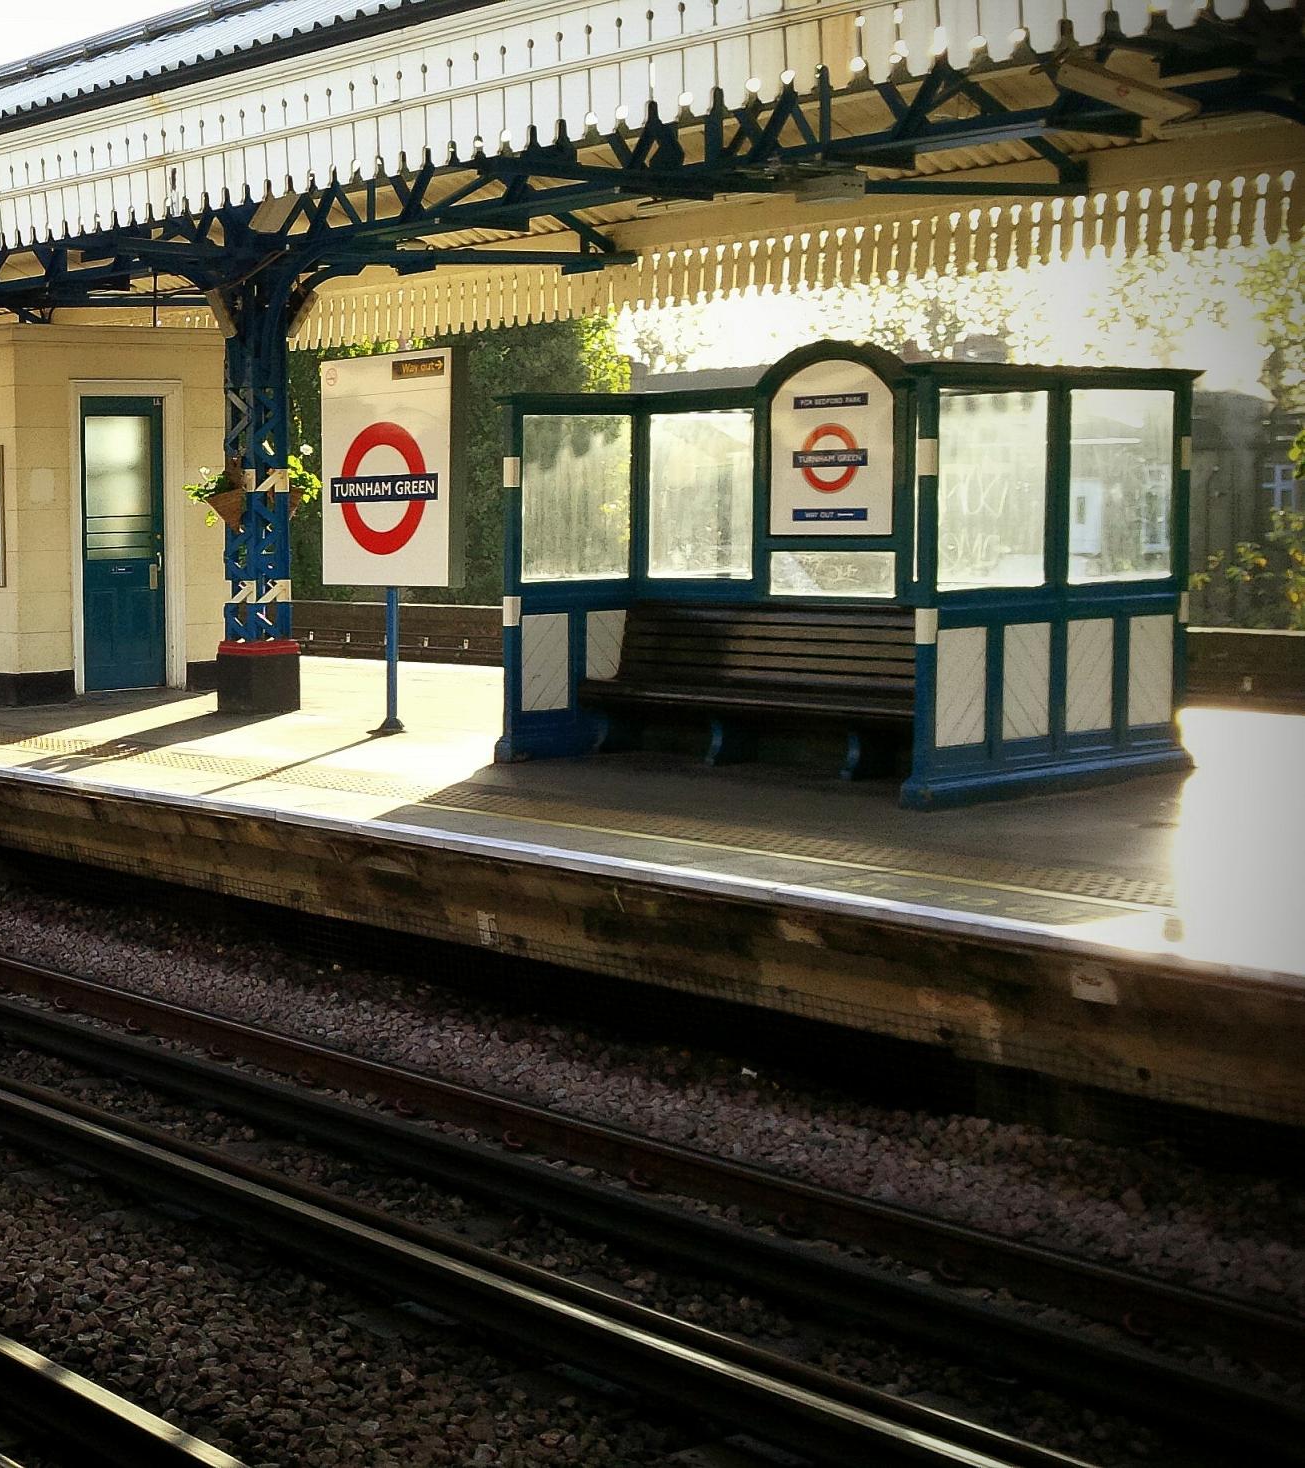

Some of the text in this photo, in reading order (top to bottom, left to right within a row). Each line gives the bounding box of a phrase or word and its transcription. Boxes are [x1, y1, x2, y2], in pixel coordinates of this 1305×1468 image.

[402, 361, 435, 374] Way out
[798, 454, 862, 464] TURNHAM GREEN
[334, 480, 435, 497] TURNHAM GREEN
